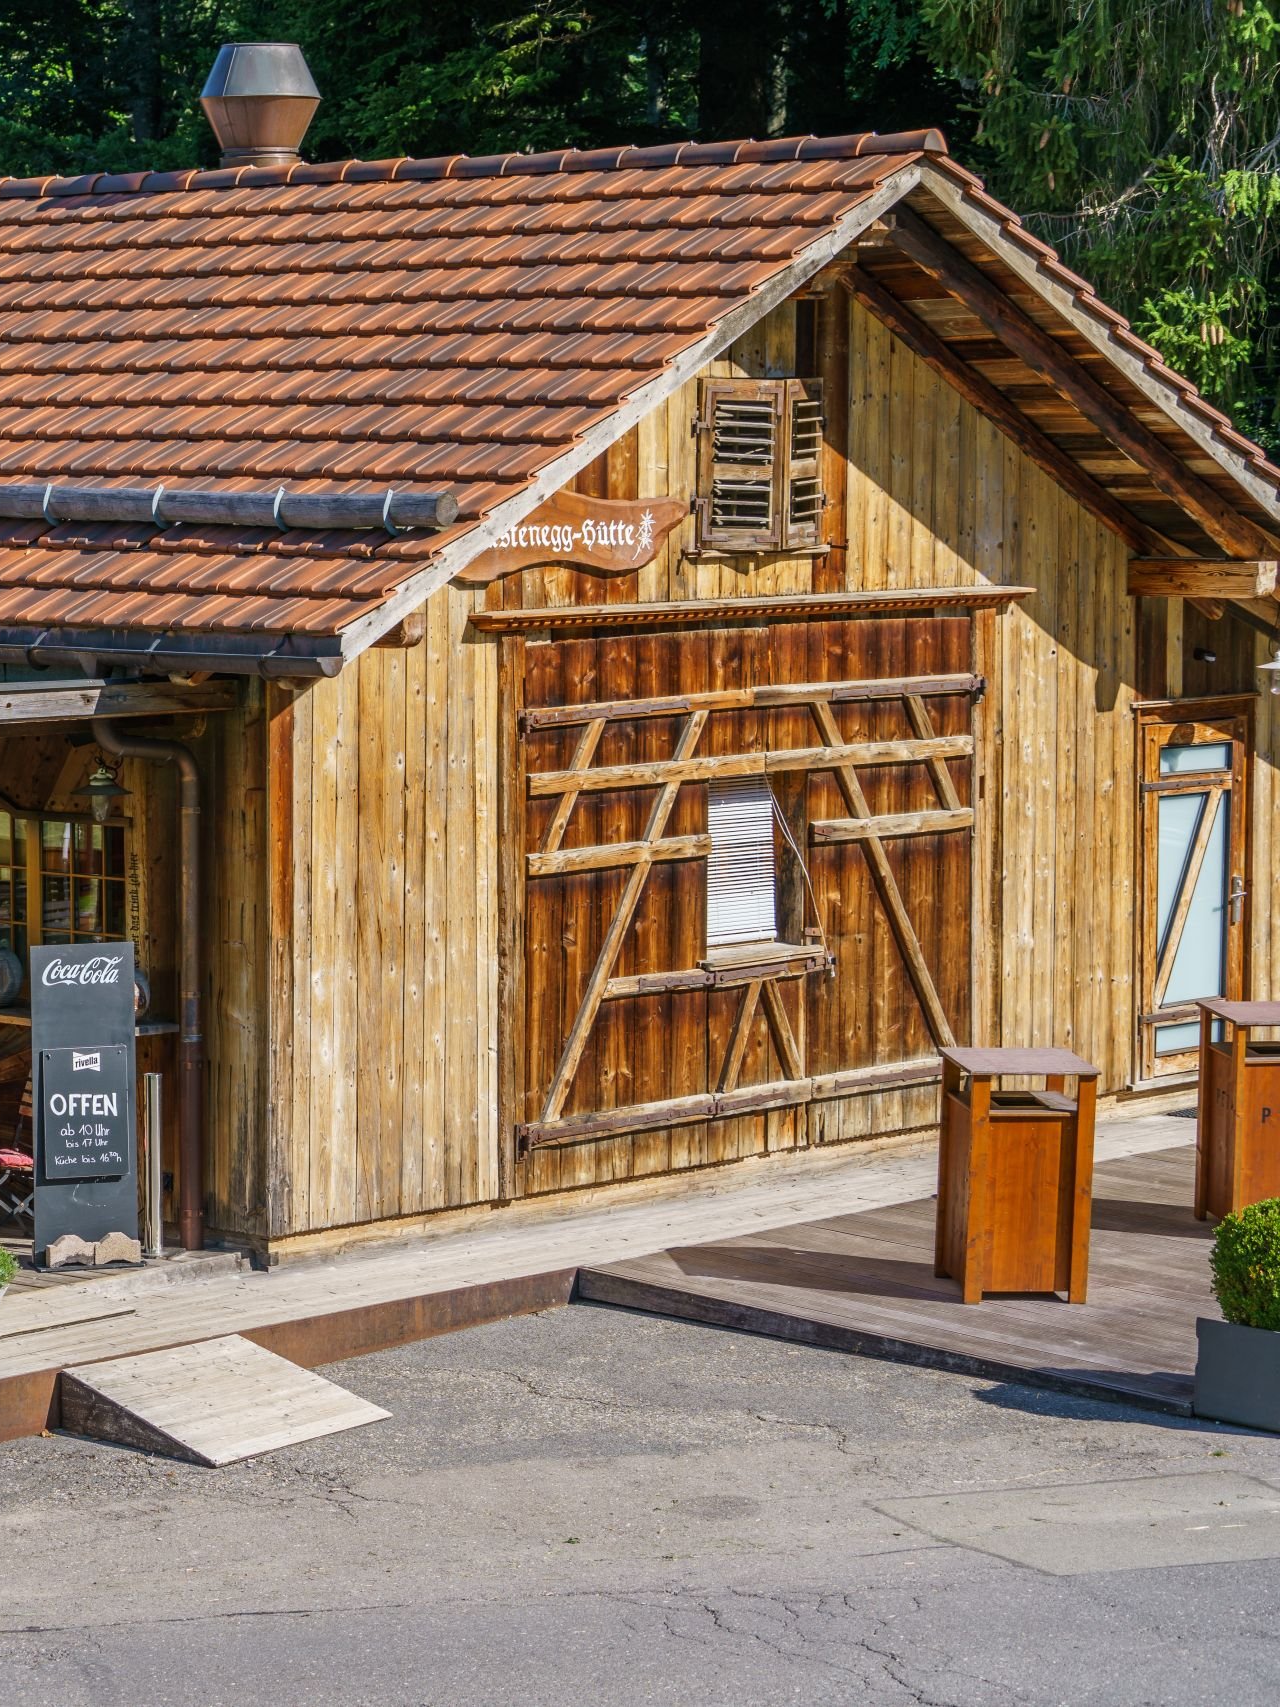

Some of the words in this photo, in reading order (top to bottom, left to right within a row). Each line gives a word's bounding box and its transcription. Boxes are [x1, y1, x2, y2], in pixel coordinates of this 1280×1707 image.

[42, 956, 124, 986] Coca-Cola
[75, 1056, 98, 1069] rivella
[50, 1092, 118, 1117] OFFEN
[60, 1122, 76, 1137] ab
[78, 1123, 93, 1136] 10
[95, 1123, 111, 1137] Uhr
[65, 1139, 80, 1149] bis
[81, 1138, 93, 1148] 17
[94, 1138, 109, 1147] Uhr
[54, 1154, 78, 1166] Küche
[81, 1154, 97, 1164] bis
